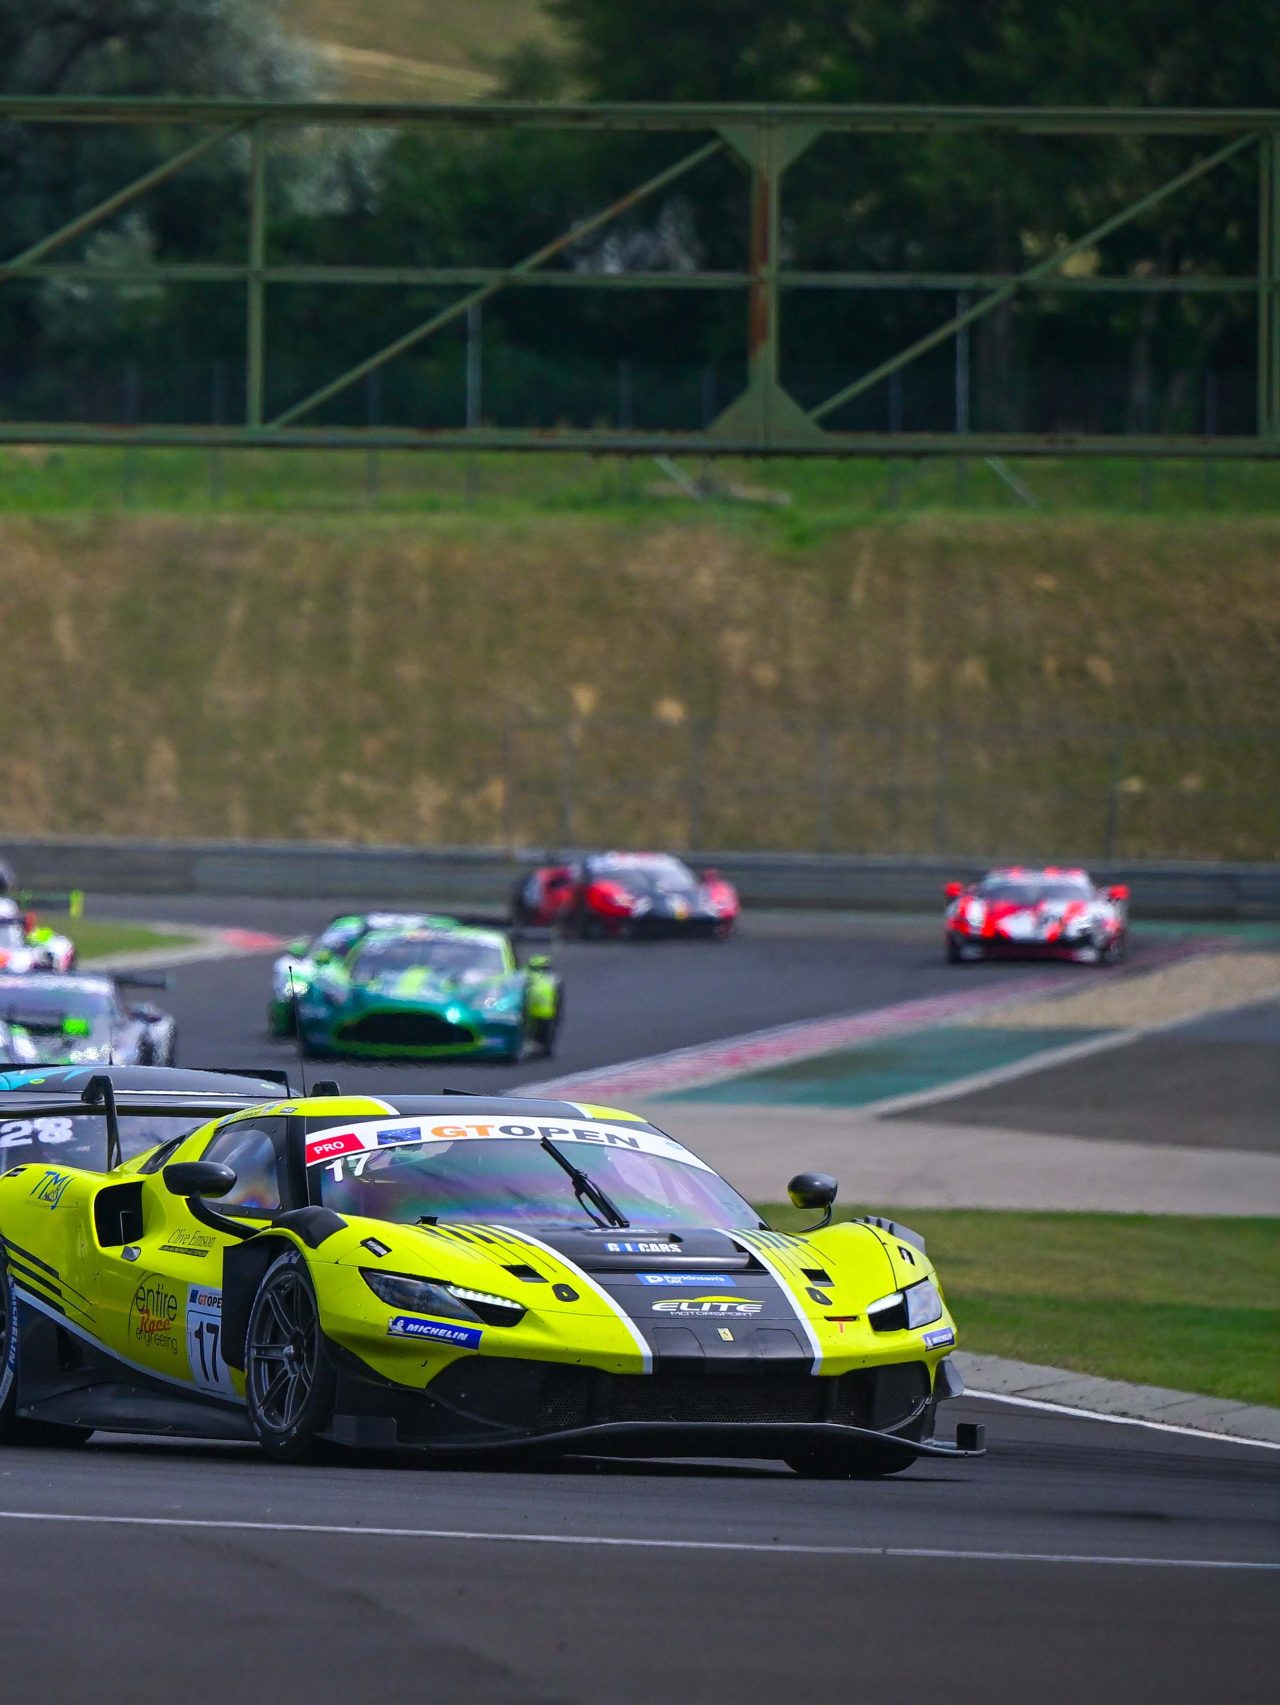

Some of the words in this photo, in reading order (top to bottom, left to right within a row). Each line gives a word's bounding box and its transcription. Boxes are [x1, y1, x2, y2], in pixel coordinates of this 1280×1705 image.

[0, 1117, 74, 1148] 28
[431, 1124, 641, 1149] GTOPEN
[312, 1140, 345, 1155] PRO
[325, 1152, 371, 1183] 17
[135, 1283, 178, 1321] entire
[198, 1294, 222, 1309] GTOPE
[651, 1301, 764, 1313] ELITE
[406, 1322, 469, 1341] MICHELIN
[194, 1320, 220, 1383] 17
